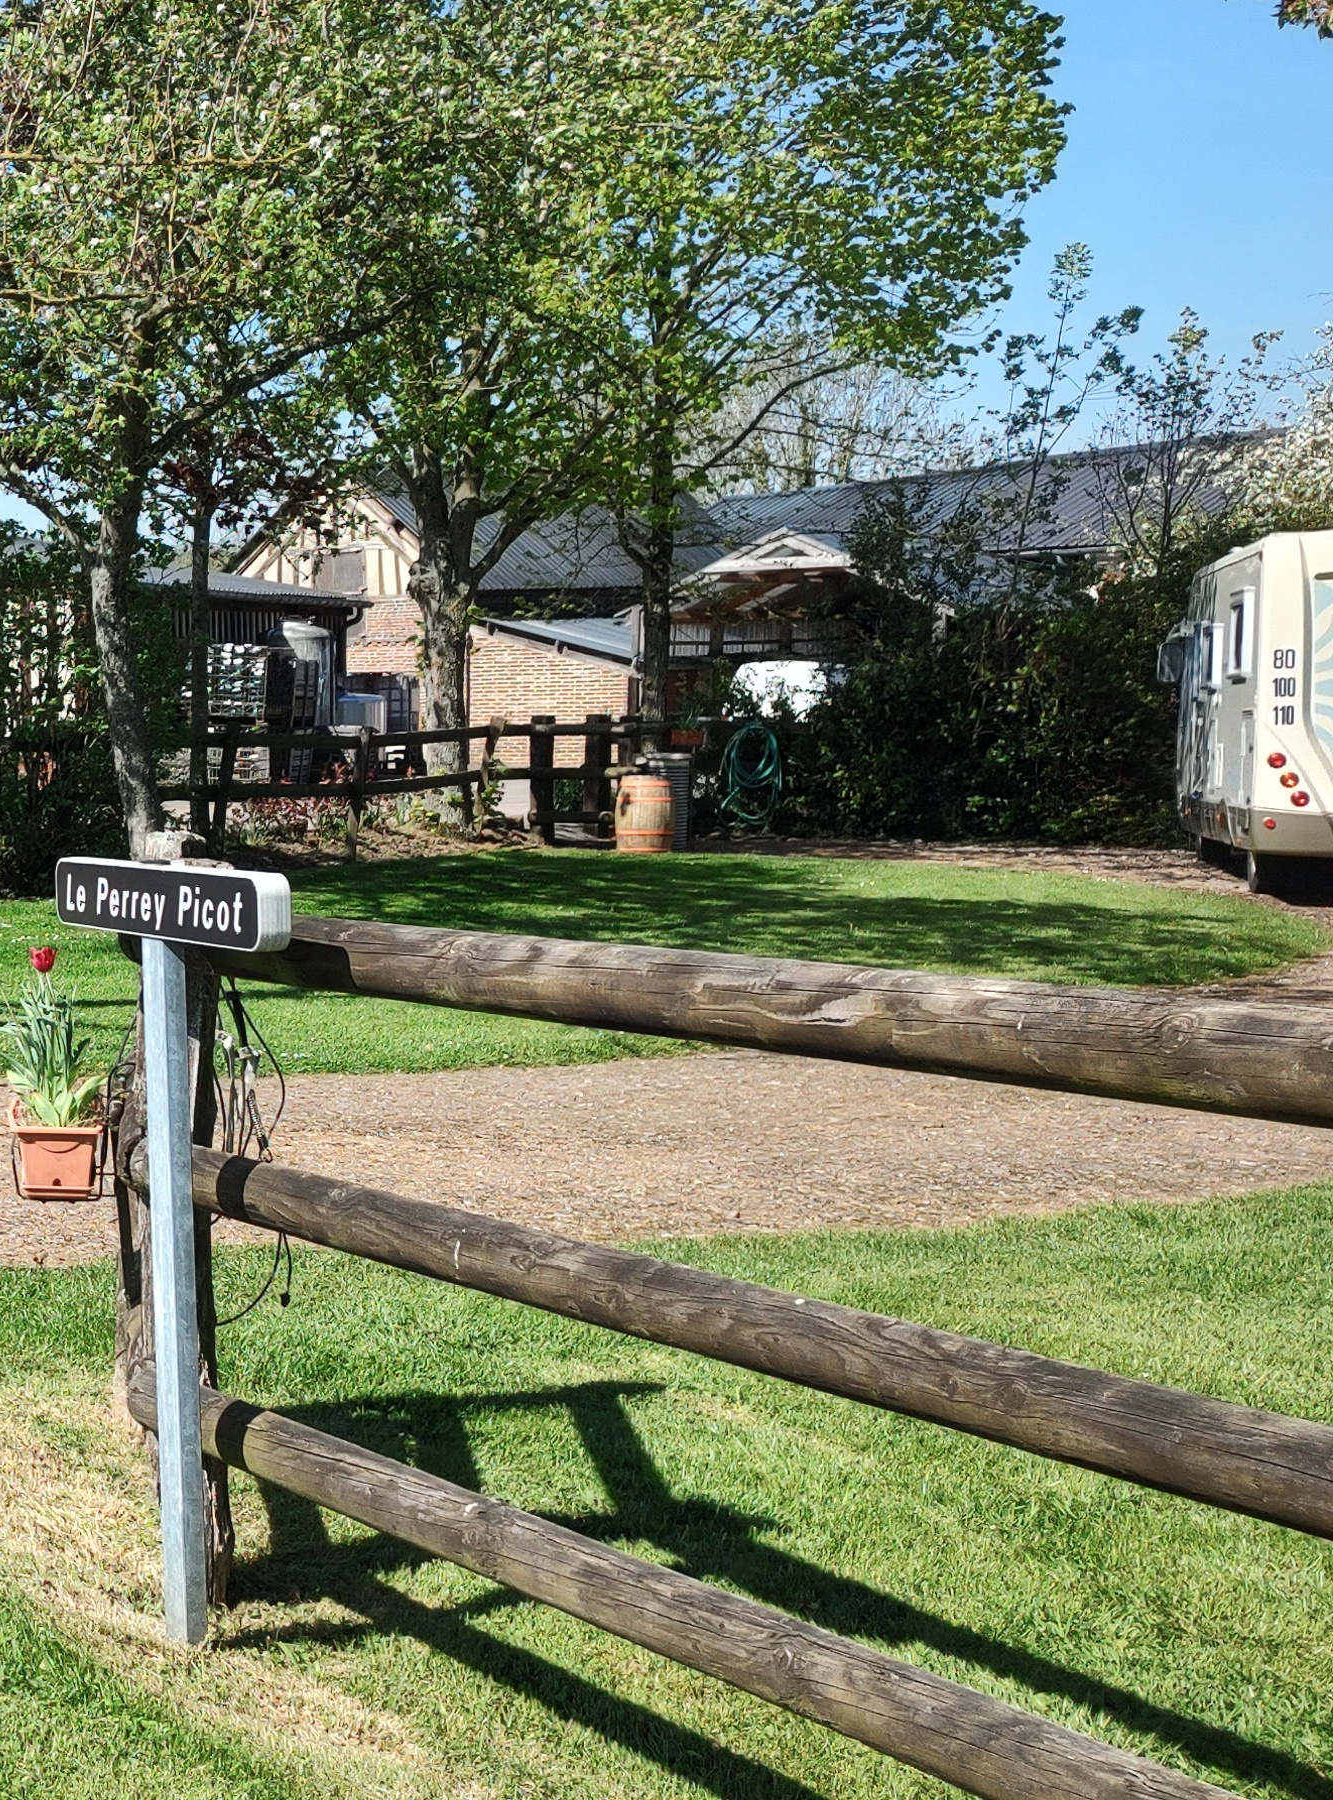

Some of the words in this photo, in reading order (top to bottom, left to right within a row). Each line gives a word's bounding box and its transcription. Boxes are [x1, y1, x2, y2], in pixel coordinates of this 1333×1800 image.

[1273, 648, 1296, 670] 80
[1272, 677, 1296, 698] 100
[1273, 705, 1295, 726] 110
[66, 872, 86, 912] Le
[96, 876, 166, 931] Perrey
[178, 884, 243, 934] Picot
